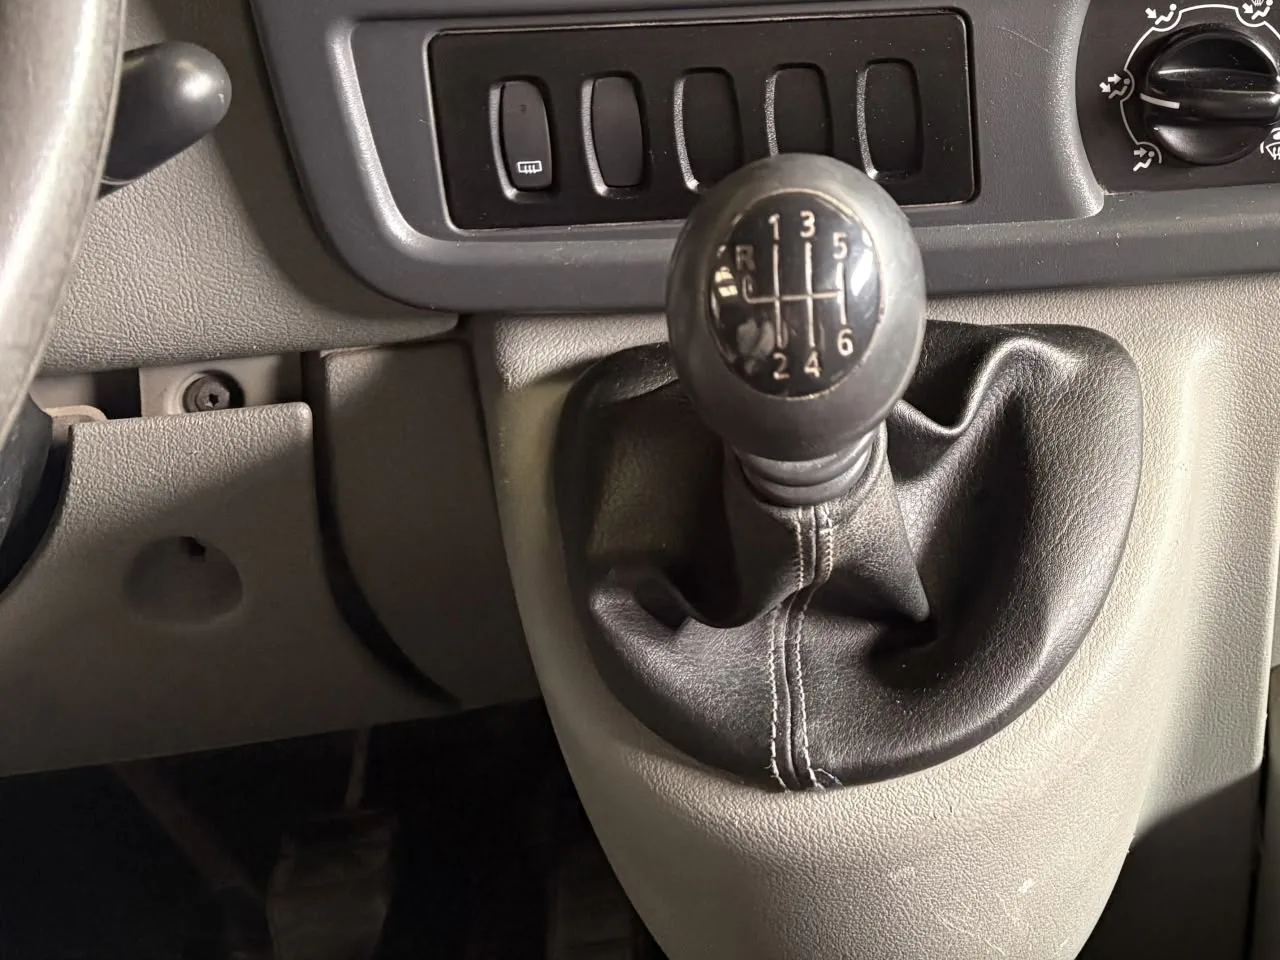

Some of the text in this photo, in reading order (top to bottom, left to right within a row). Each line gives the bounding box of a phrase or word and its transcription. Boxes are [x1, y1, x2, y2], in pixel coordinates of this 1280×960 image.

[768, 213, 781, 240] 1
[800, 210, 816, 238] 3
[735, 244, 756, 271] R
[832, 232, 848, 260] 5
[837, 329, 854, 356] 6
[772, 353, 790, 380] 2
[804, 350, 821, 378] 4
